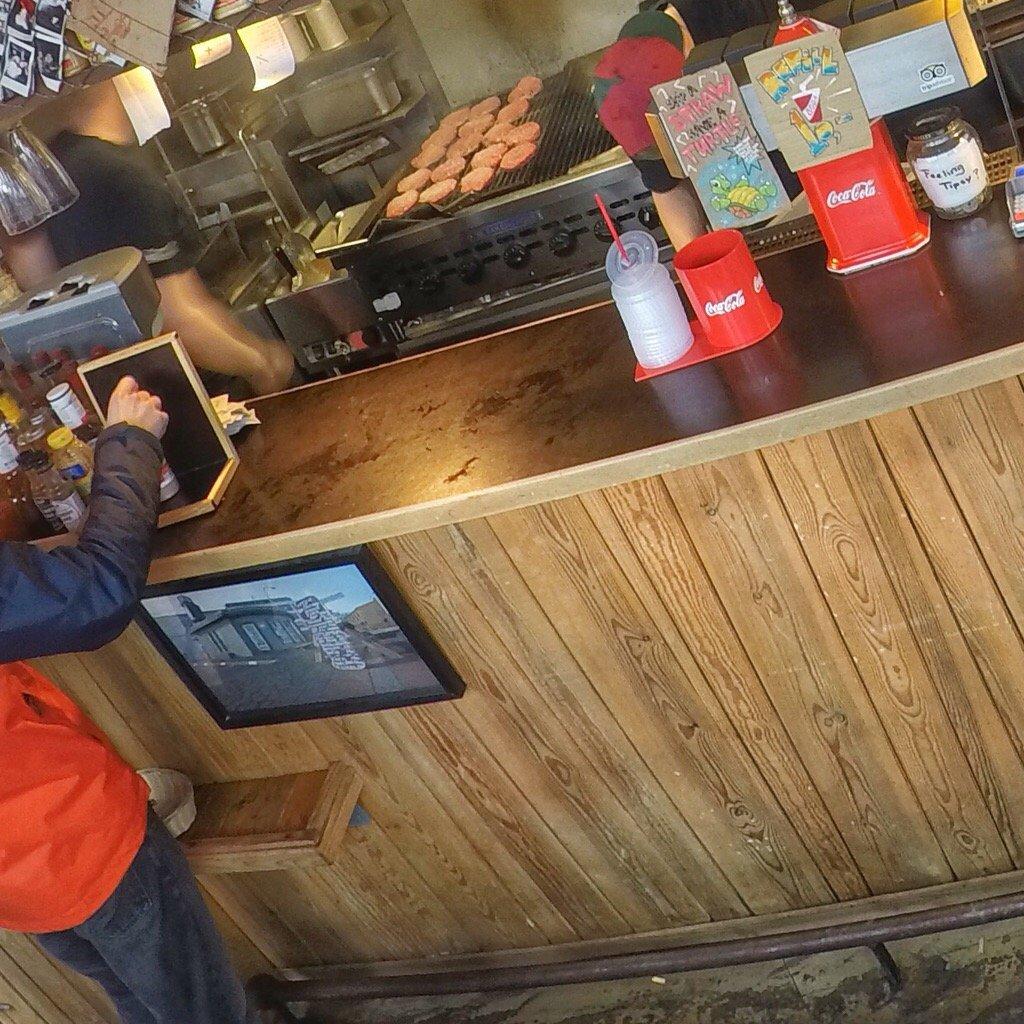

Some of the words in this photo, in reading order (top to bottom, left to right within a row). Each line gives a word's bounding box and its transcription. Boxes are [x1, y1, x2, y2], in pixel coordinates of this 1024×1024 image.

[666, 74, 733, 132] STRAW
[920, 164, 966, 180] Feeling
[826, 177, 877, 210] Coca-Cola
[704, 289, 746, 317] Coca-Cola
